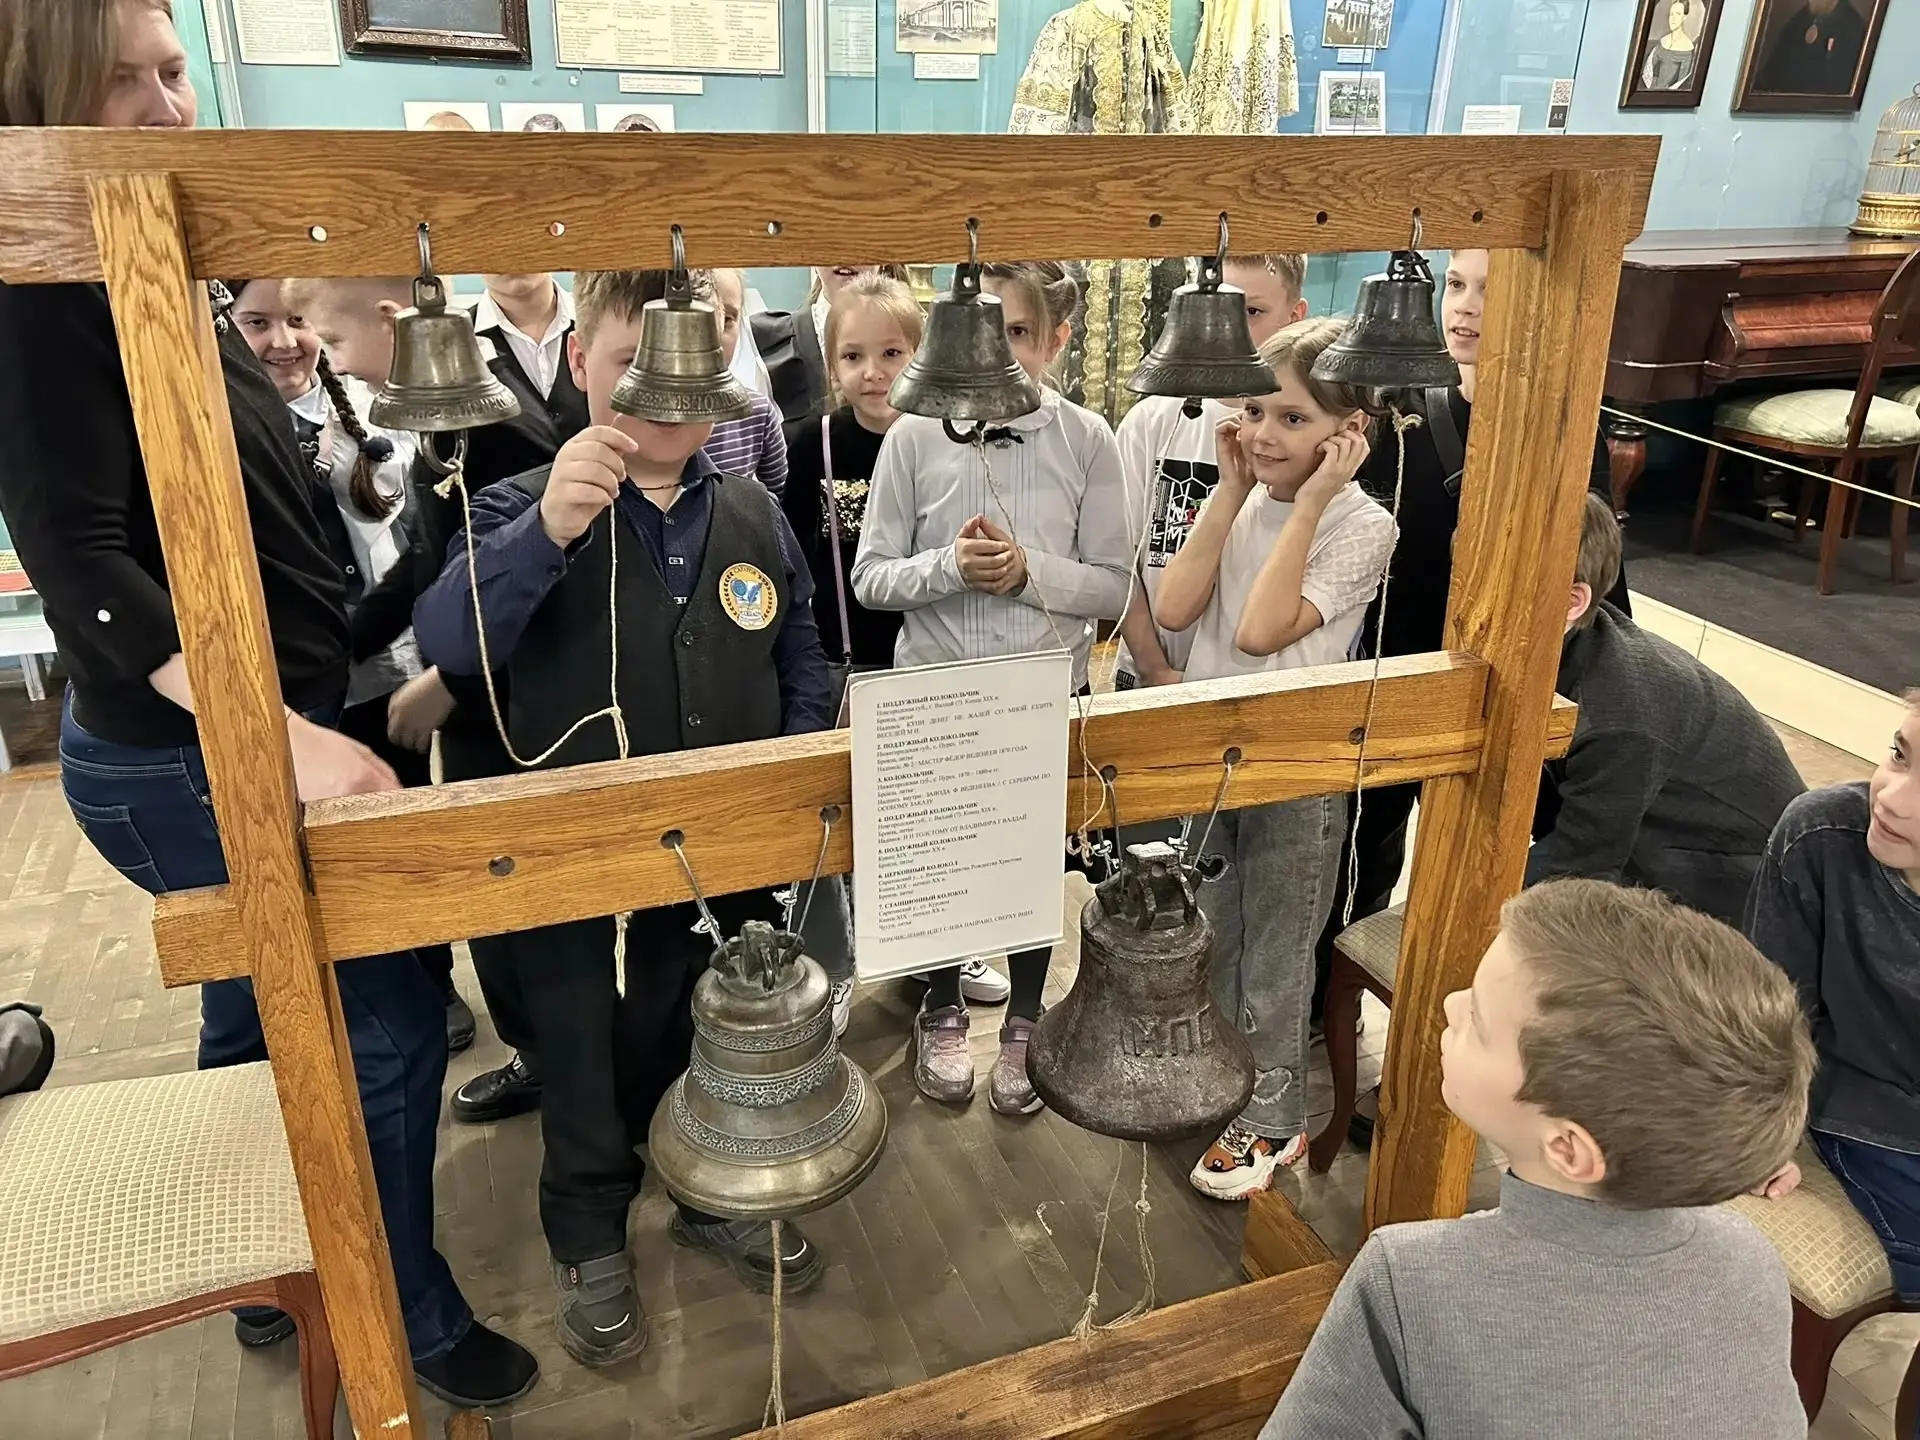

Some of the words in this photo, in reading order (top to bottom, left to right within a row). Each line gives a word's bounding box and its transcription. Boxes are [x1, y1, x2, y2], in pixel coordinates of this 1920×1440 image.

[883, 697, 928, 708] ПОДДУЖНЫЙ
[930, 690, 980, 702] КОЛОКОЛЬЧИК
[883, 738, 928, 749] ПОДДУЖНЫЙ
[929, 730, 979, 743] КОЛОКОЛЬЧИК
[918, 757, 944, 766] МАСТЕР
[884, 770, 934, 782] КОЛОКОЛЬЧИК
[884, 810, 928, 822] ПОДДУЖНЫЙ
[929, 802, 978, 815] КОЛОКОЛЬЧИК
[884, 842, 928, 854] ПОДДУЖНЫЙ
[929, 833, 978, 846] КОЛОКОЛЬЧИК
[885, 866, 926, 878] ЦЕРКОВНЫЙ
[927, 861, 958, 871] КОЛОКОЛ
[937, 889, 968, 899] КОЛОКОЛ
